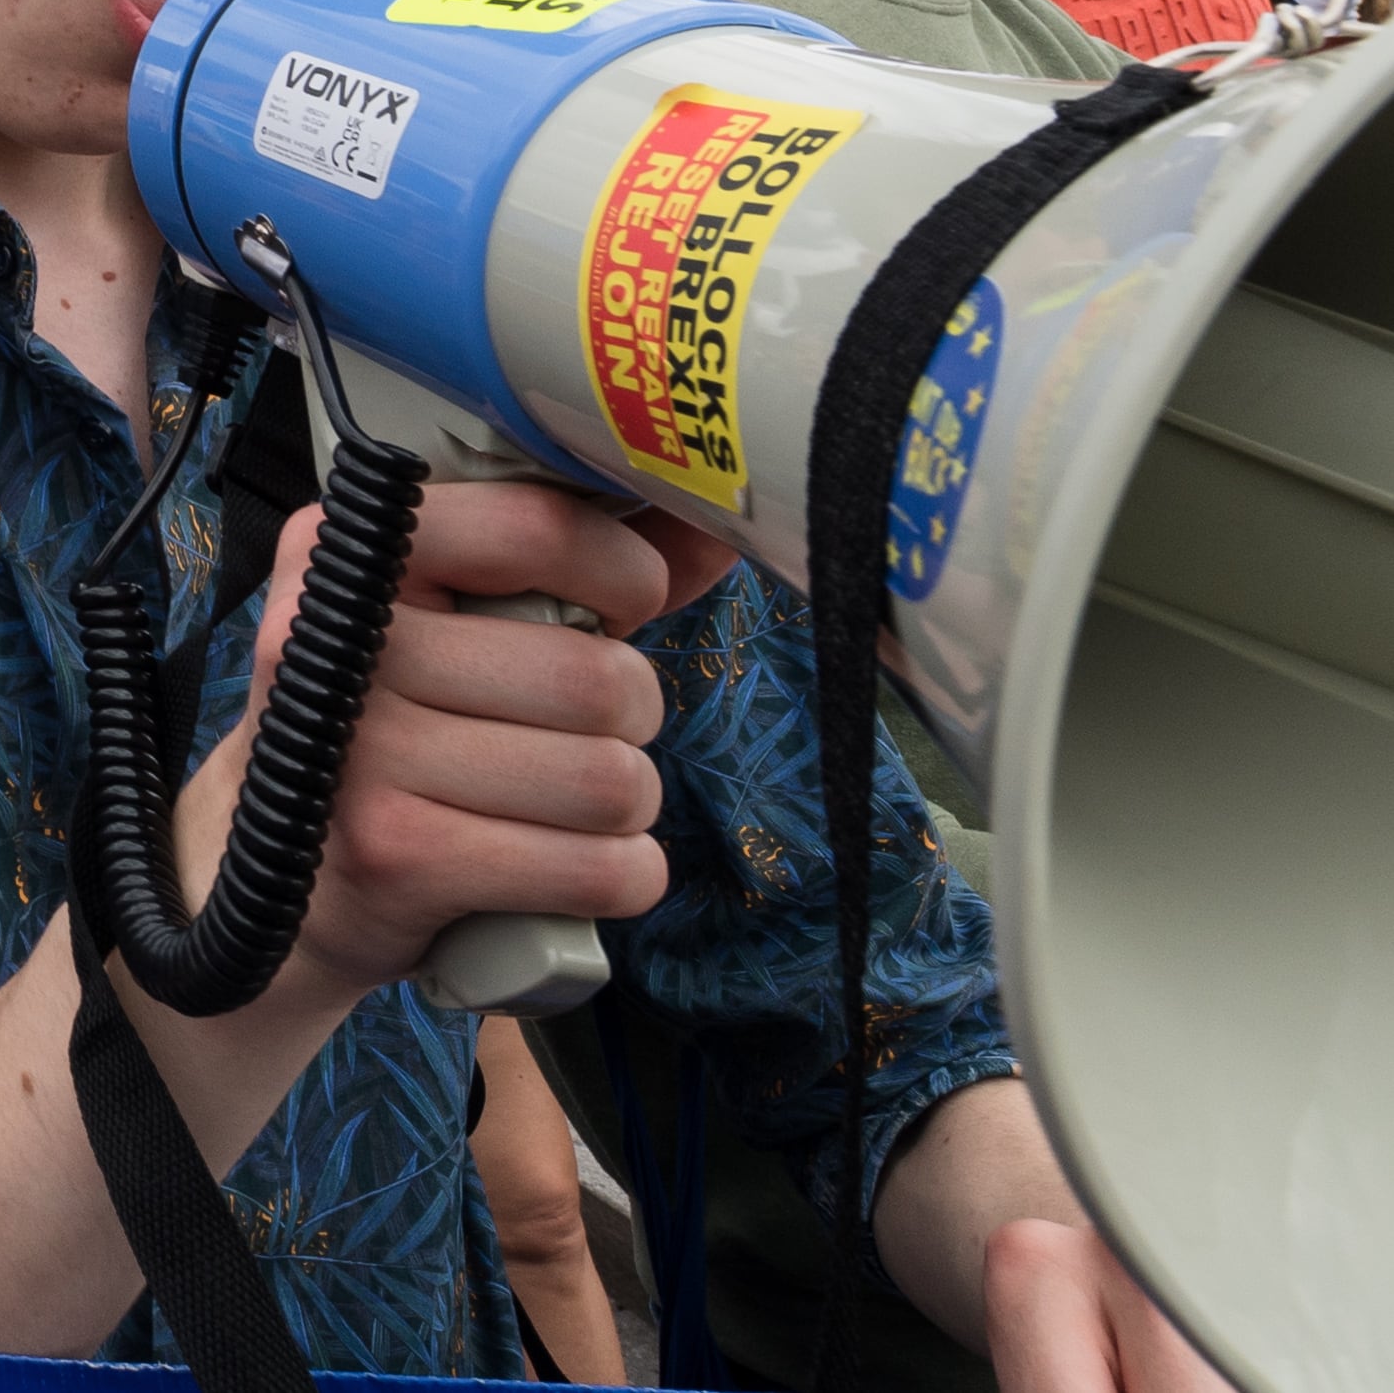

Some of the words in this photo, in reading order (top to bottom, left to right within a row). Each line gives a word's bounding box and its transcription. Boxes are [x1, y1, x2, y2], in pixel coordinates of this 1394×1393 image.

[286, 57, 410, 125] VONYX
[651, 112, 757, 256] RESET
[718, 126, 799, 192] TO
[603, 151, 688, 393] REJOIN
[634, 267, 684, 465] REPAIR
[667, 212, 728, 470] BREXIT
[698, 127, 841, 475] BOLLOCKS
